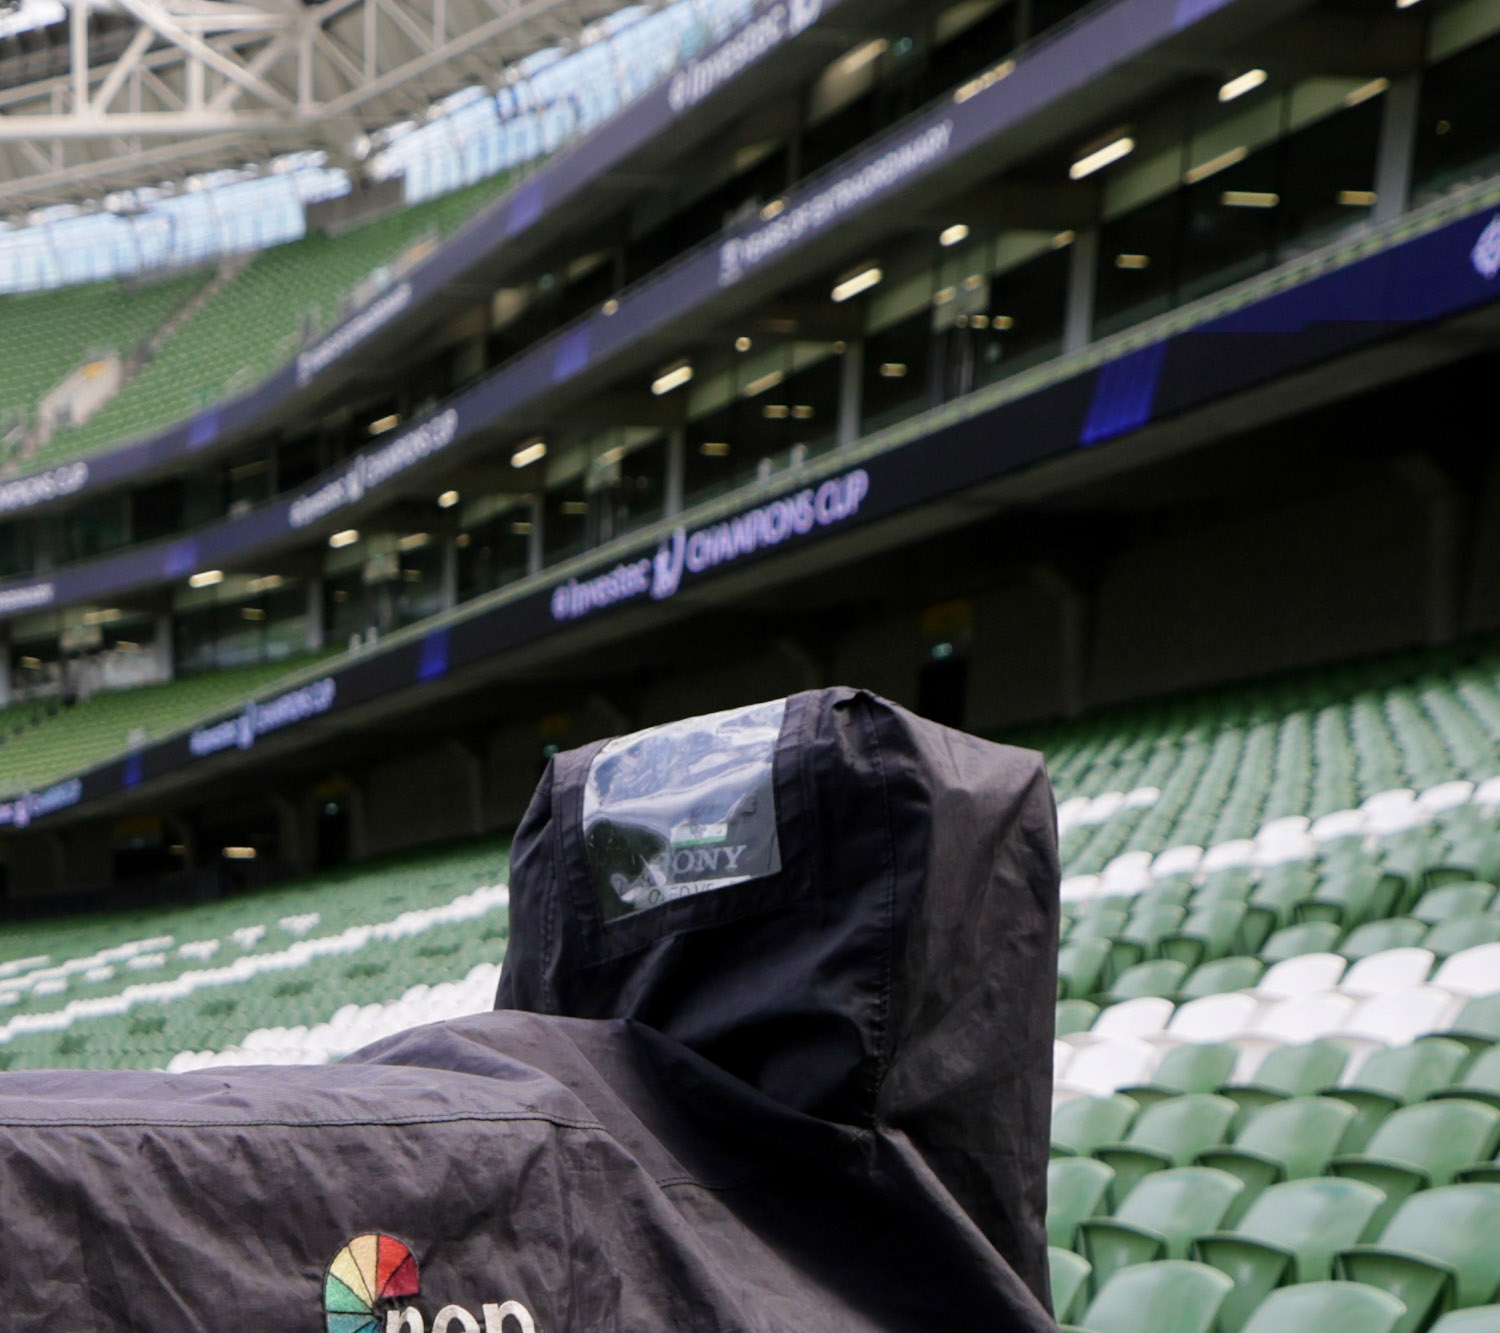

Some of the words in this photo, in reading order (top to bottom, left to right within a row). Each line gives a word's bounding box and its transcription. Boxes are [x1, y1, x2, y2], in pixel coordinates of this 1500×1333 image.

[686, 489, 815, 573] CHAMPIONS
[813, 468, 870, 525] CUP
[672, 845, 747, 874] ONY
